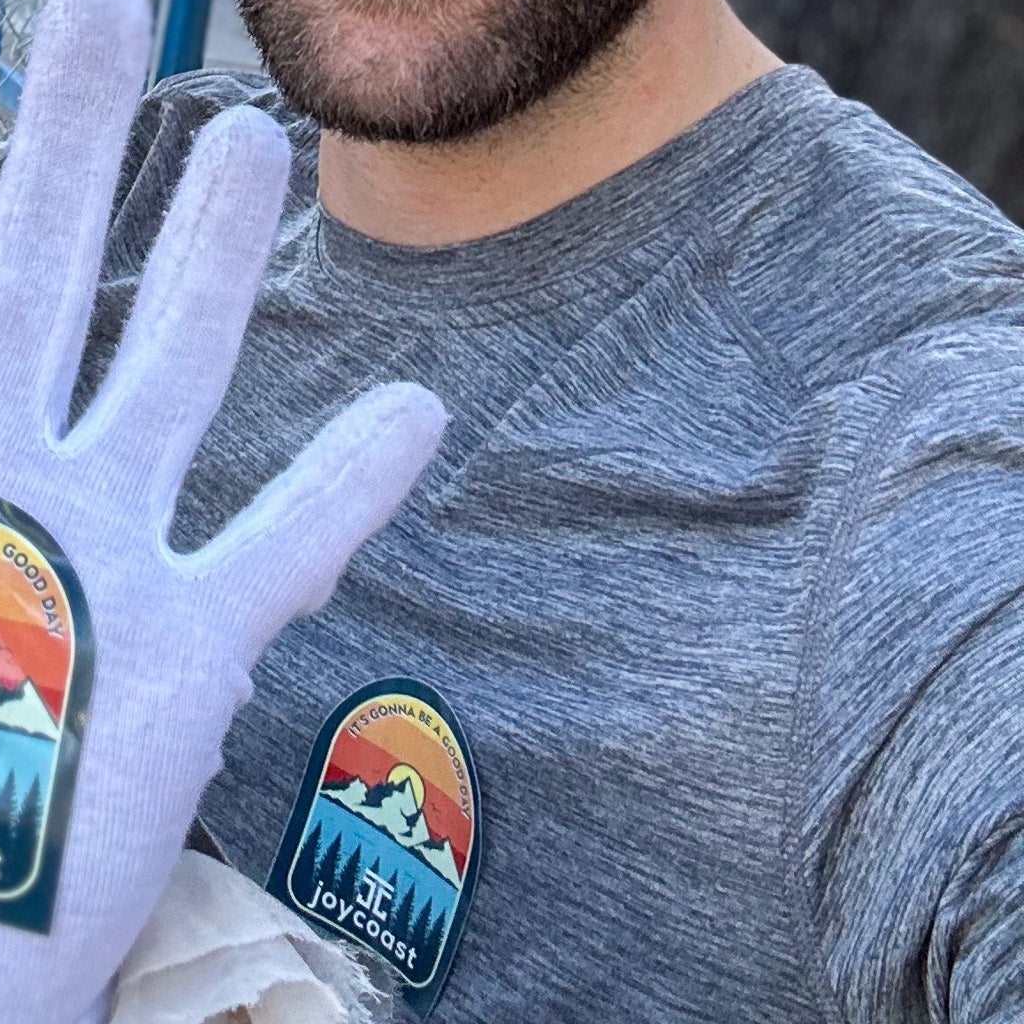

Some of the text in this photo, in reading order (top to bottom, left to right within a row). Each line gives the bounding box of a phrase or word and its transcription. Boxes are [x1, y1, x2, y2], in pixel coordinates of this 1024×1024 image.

[3, 543, 48, 591] GOOD
[42, 596, 63, 637] DAY
[349, 703, 471, 817] IT'S GONNA BE A GOOD DAY
[307, 881, 417, 969] joycoast
